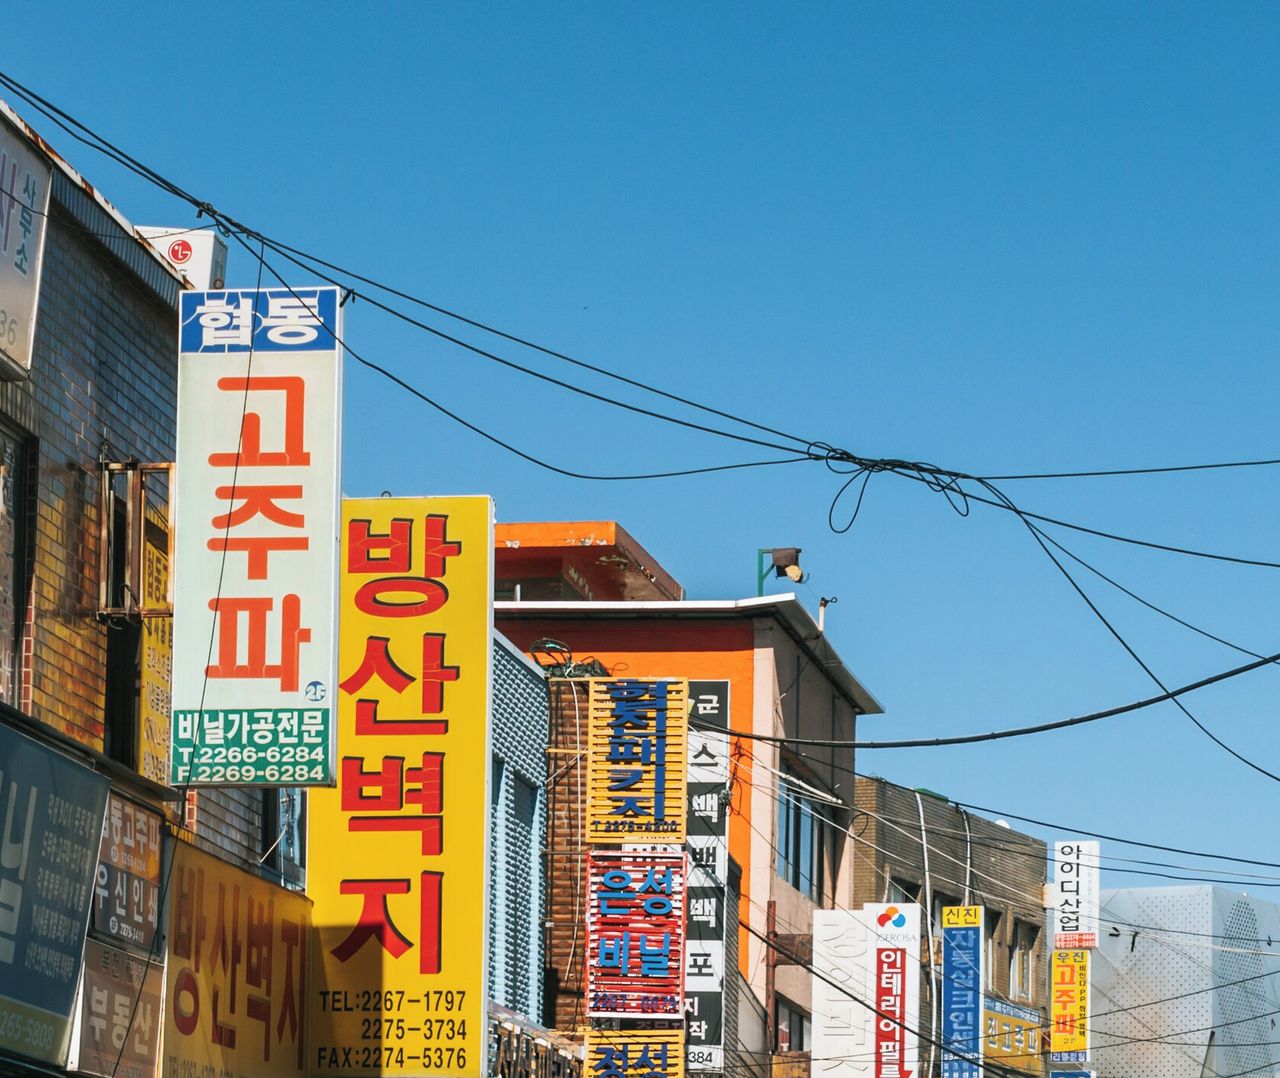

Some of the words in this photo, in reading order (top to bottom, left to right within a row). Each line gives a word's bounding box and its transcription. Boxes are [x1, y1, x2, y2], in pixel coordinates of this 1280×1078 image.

[197, 297, 324, 346] 협동
[204, 376, 312, 692] 고주파
[177, 711, 325, 745] 비닐가공전문
[330, 513, 462, 976] 방산벽지
[177, 746, 325, 764] T.2266-6284
[177, 765, 325, 783] F.2269-6284
[597, 868, 675, 916] 은성
[1060, 845, 1083, 932] 아이디산업
[946, 907, 978, 925] 신진
[173, 862, 307, 1072] 방산벽지
[598, 931, 671, 977] 비닐
[1056, 952, 1085, 964] 우진
[89, 984, 154, 1051] 부동산
[319, 990, 467, 1013] TEL:2267-1797
[1054, 964, 1077, 1036] 고주파
[361, 1018, 467, 1041] 2275-3734
[318, 1046, 467, 1070] FAX:2274-5376
